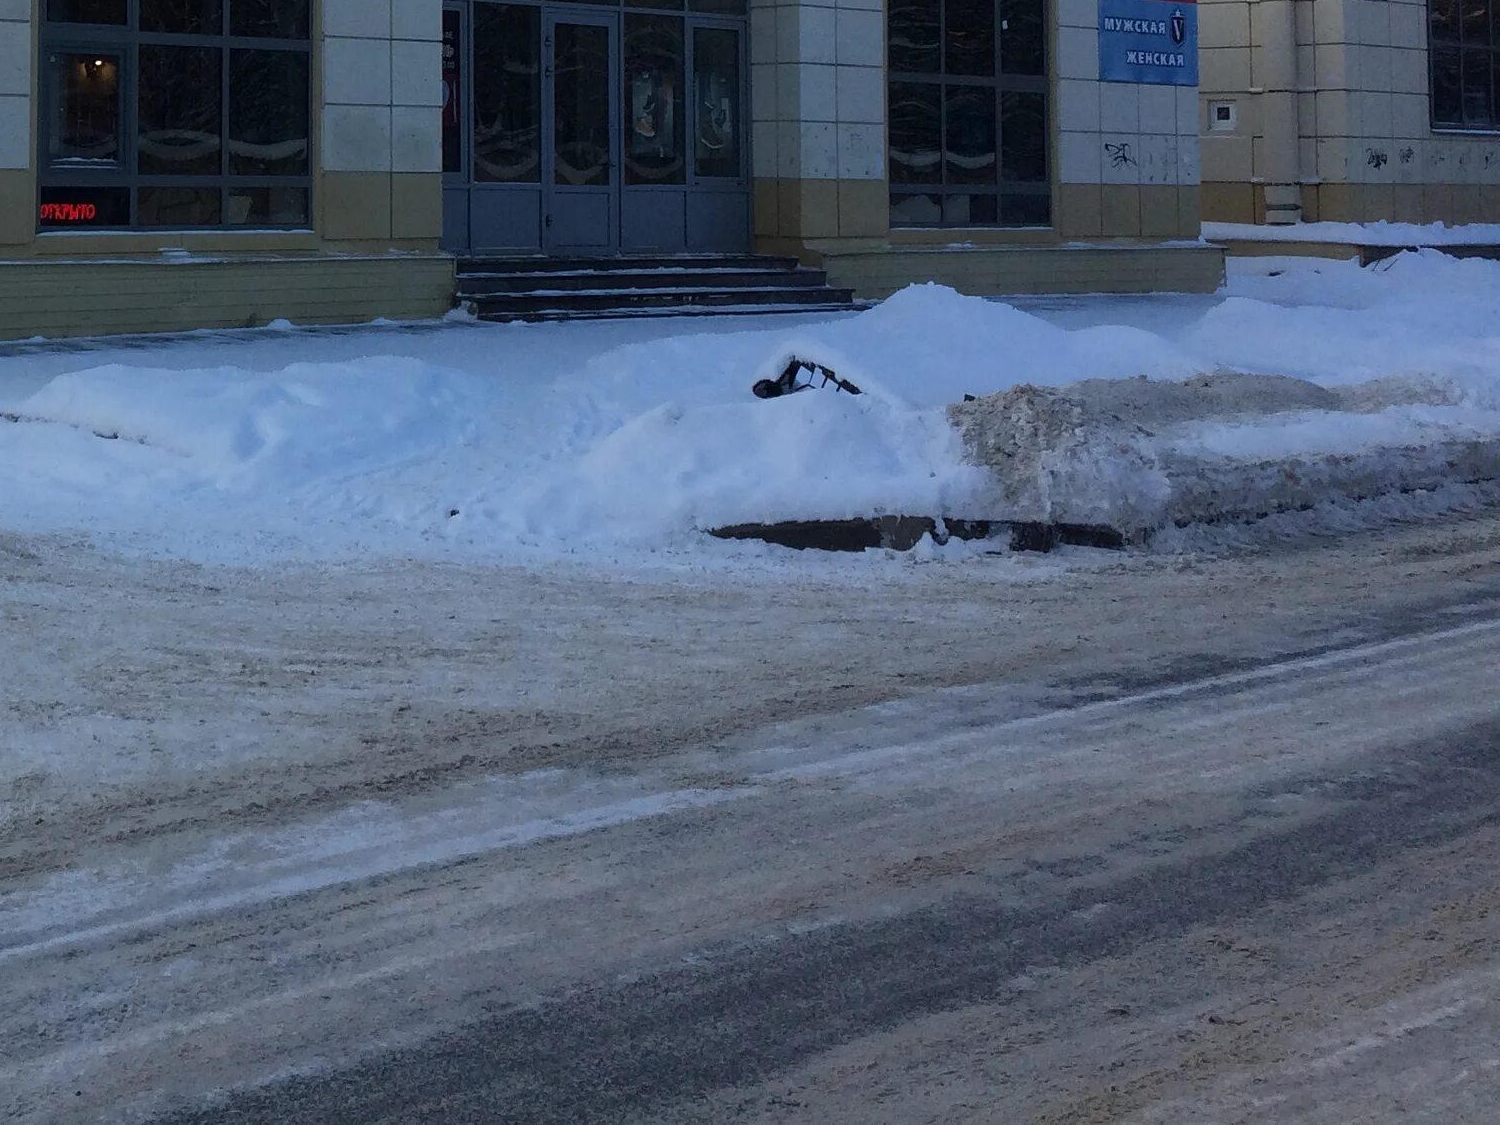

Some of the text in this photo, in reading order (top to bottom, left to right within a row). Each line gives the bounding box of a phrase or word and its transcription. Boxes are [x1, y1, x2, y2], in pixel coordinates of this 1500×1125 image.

[1104, 17, 1166, 35] МУЖСКАЯ
[1126, 51, 1185, 67] ЖЕНСКАЯ
[40, 203, 96, 220] ОТКРЫТО
